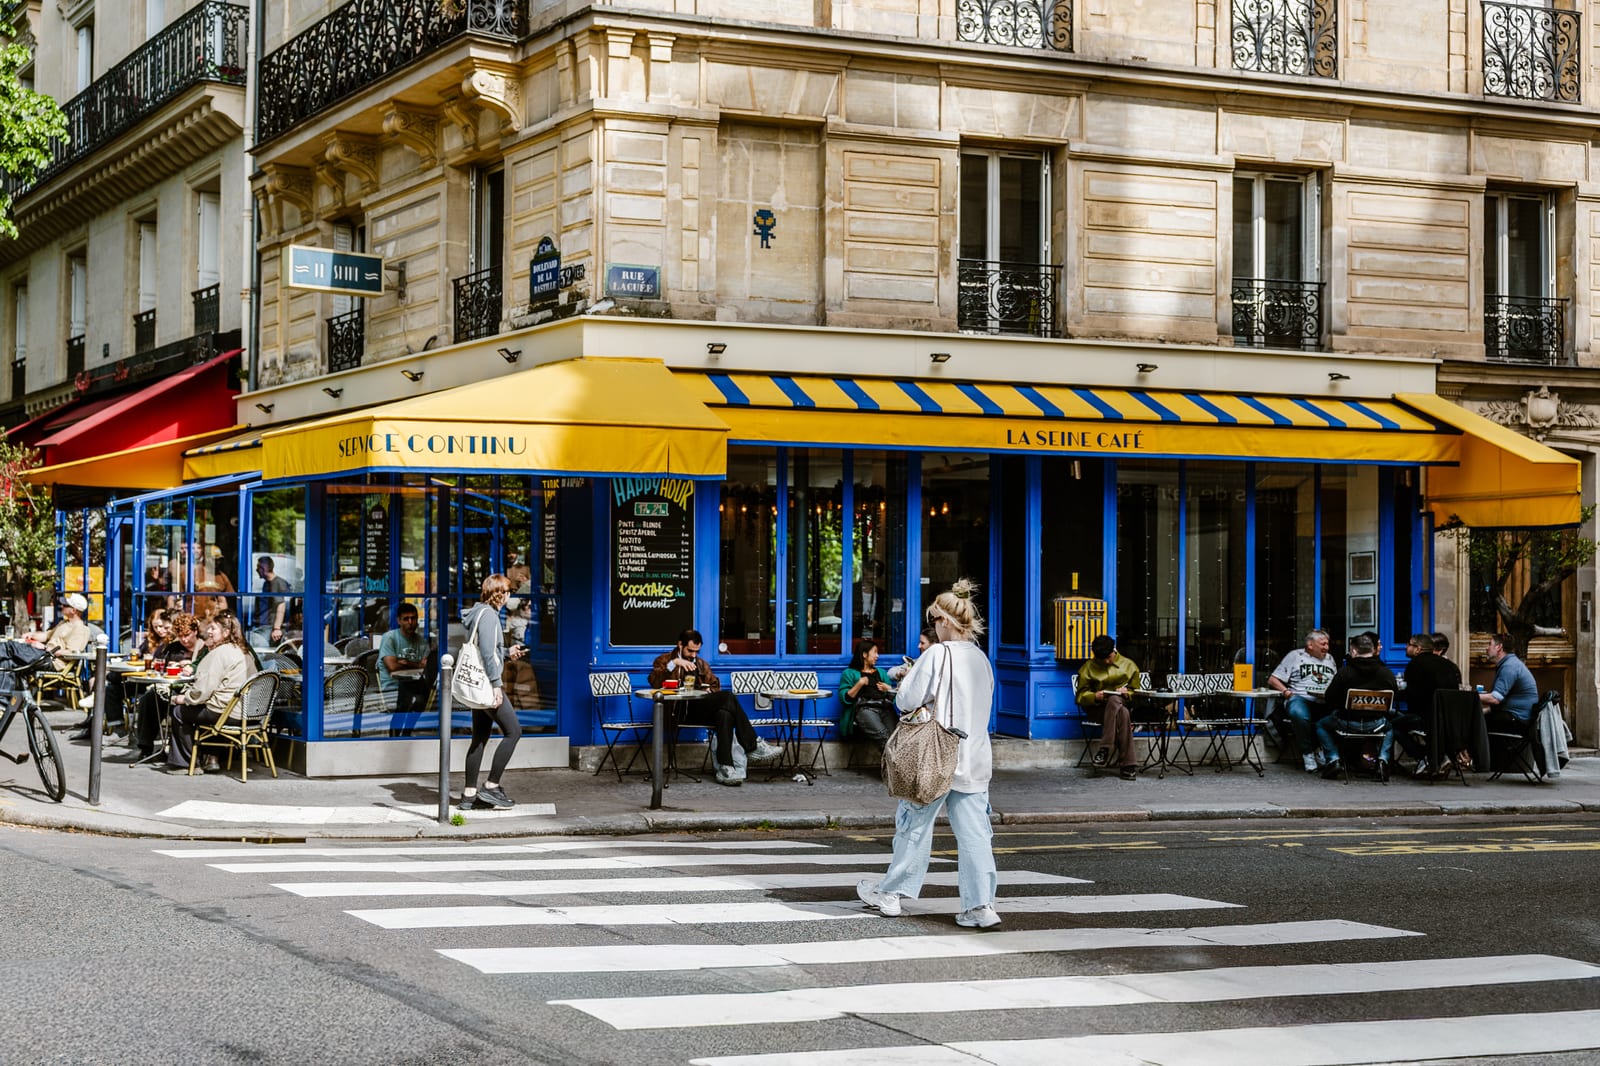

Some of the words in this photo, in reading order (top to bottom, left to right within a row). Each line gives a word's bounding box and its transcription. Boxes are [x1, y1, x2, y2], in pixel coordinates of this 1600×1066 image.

[533, 259, 558, 274] BOULEVARD
[537, 274, 545, 283] DE
[545, 271, 553, 281] LA
[621, 270, 644, 281] RUE
[533, 280, 558, 295] BASTILLE
[612, 280, 654, 294] LACUÉE
[338, 433, 400, 458] SERVICE
[407, 433, 527, 456] CONTINU
[1007, 429, 1031, 445] LA
[1036, 430, 1092, 448] SEINE
[1096, 430, 1145, 449] CAFÉ
[612, 478, 661, 508] HAPPY
[659, 478, 694, 512] HOUR
[642, 520, 662, 529] BLONDE
[618, 536, 642, 544] MOJITO
[618, 544, 629, 552] GIN
[622, 597, 677, 610] Moment
